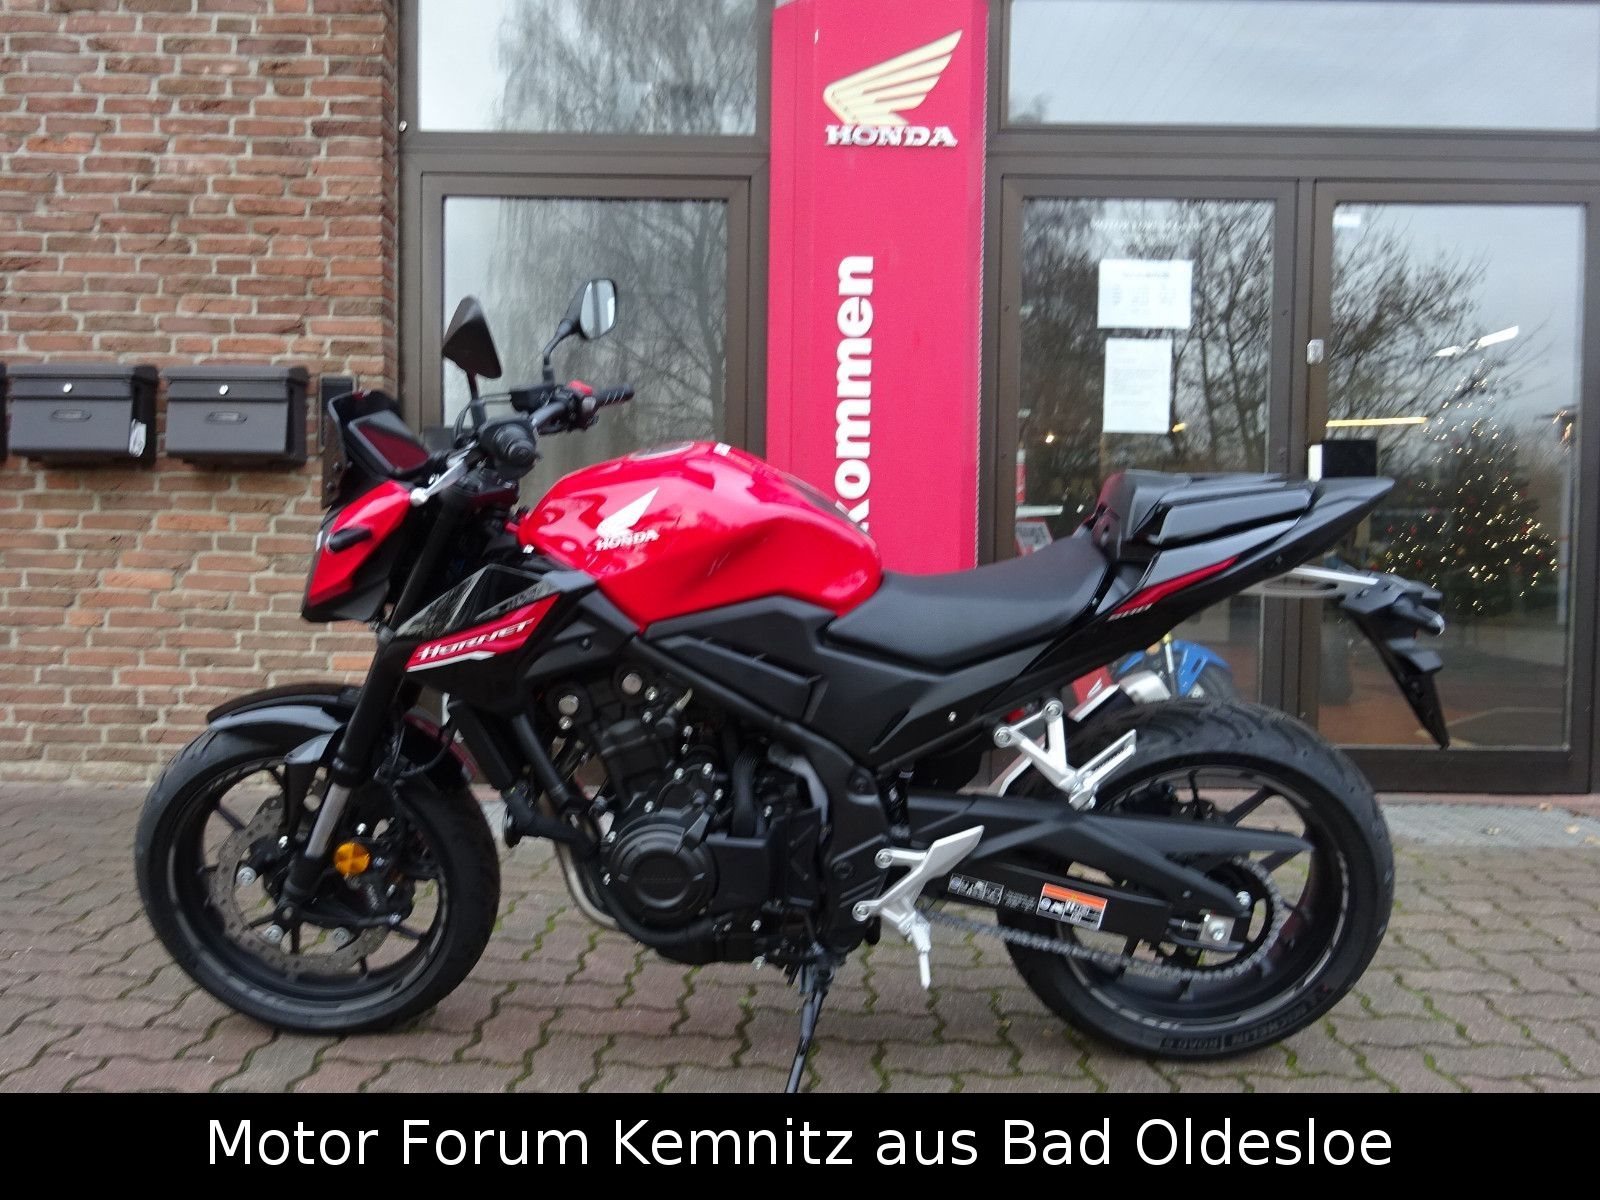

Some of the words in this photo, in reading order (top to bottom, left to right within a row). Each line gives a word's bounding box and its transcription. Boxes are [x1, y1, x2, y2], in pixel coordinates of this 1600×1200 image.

[825, 124, 959, 148] HONDA
[594, 529, 661, 552] HONDA
[417, 617, 536, 661] HORNET
